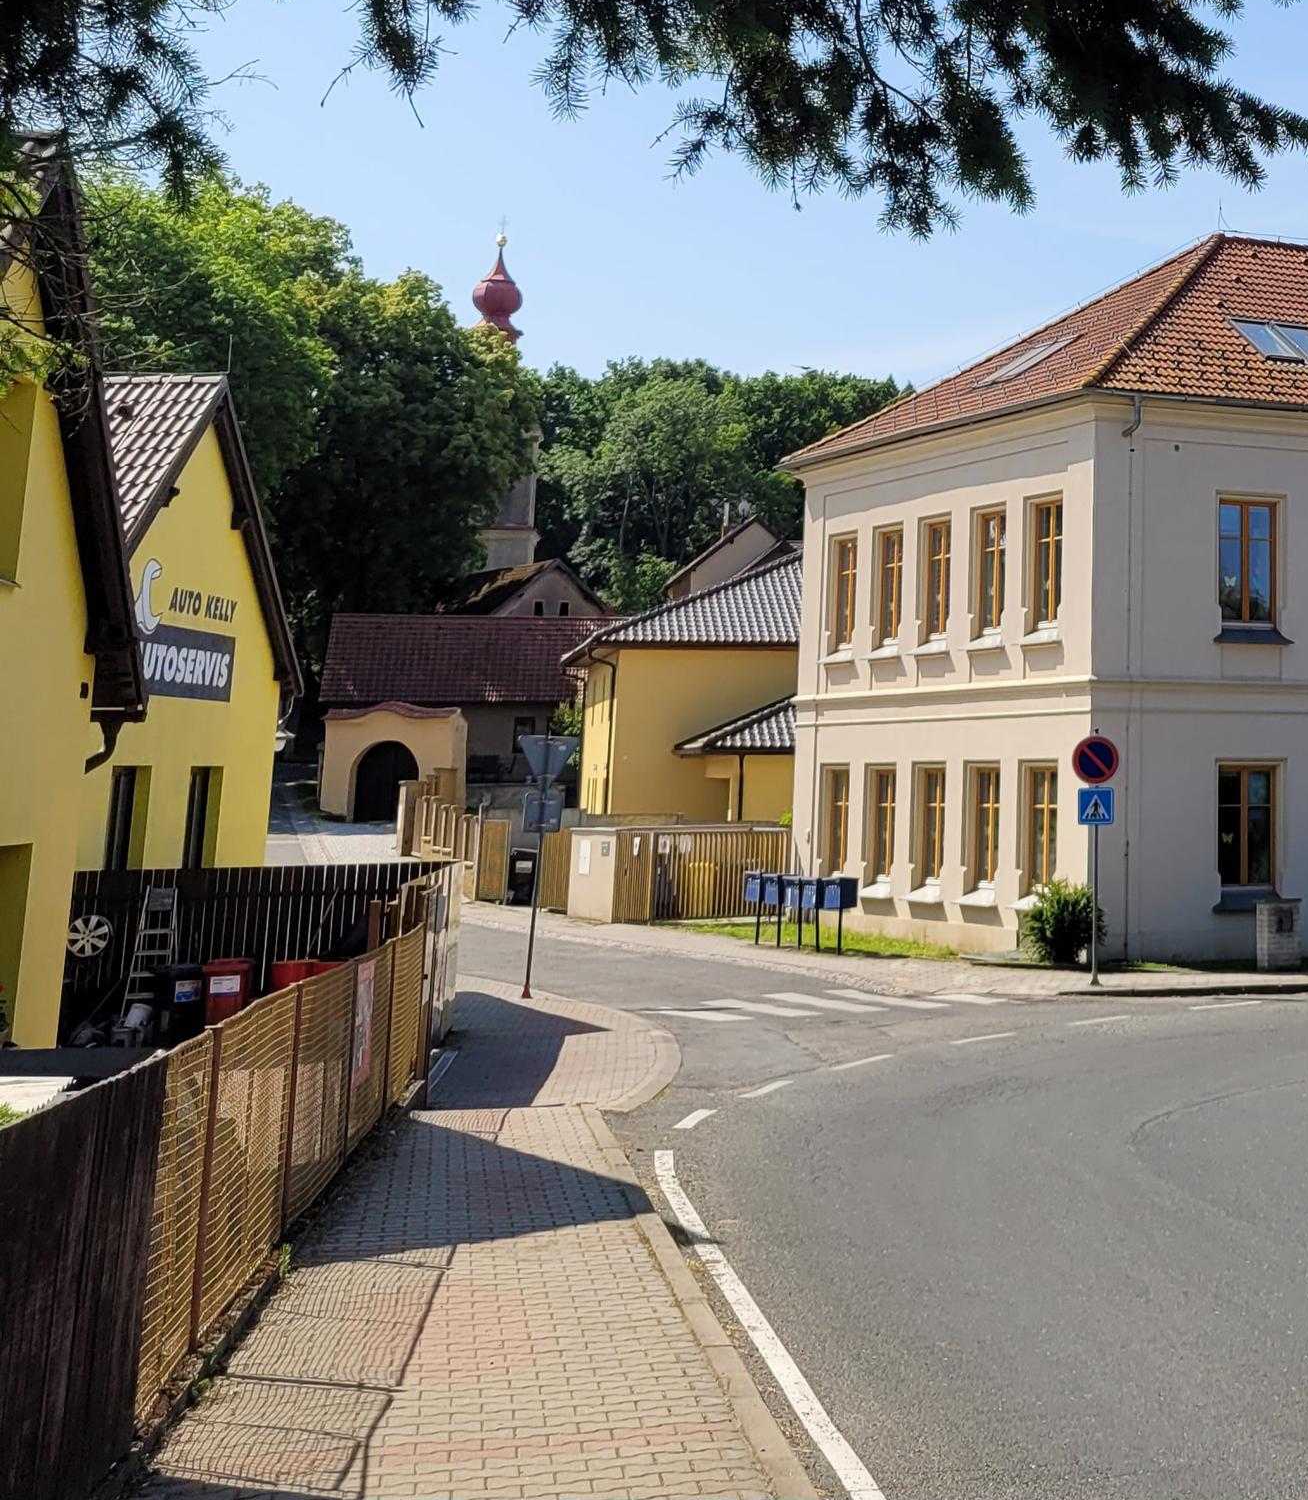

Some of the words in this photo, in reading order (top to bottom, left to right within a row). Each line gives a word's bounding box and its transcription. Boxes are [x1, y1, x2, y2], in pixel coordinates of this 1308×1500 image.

[169, 587, 202, 616] AUTO
[204, 595, 238, 624] KELLY
[140, 641, 231, 688] UTOSERVIS
